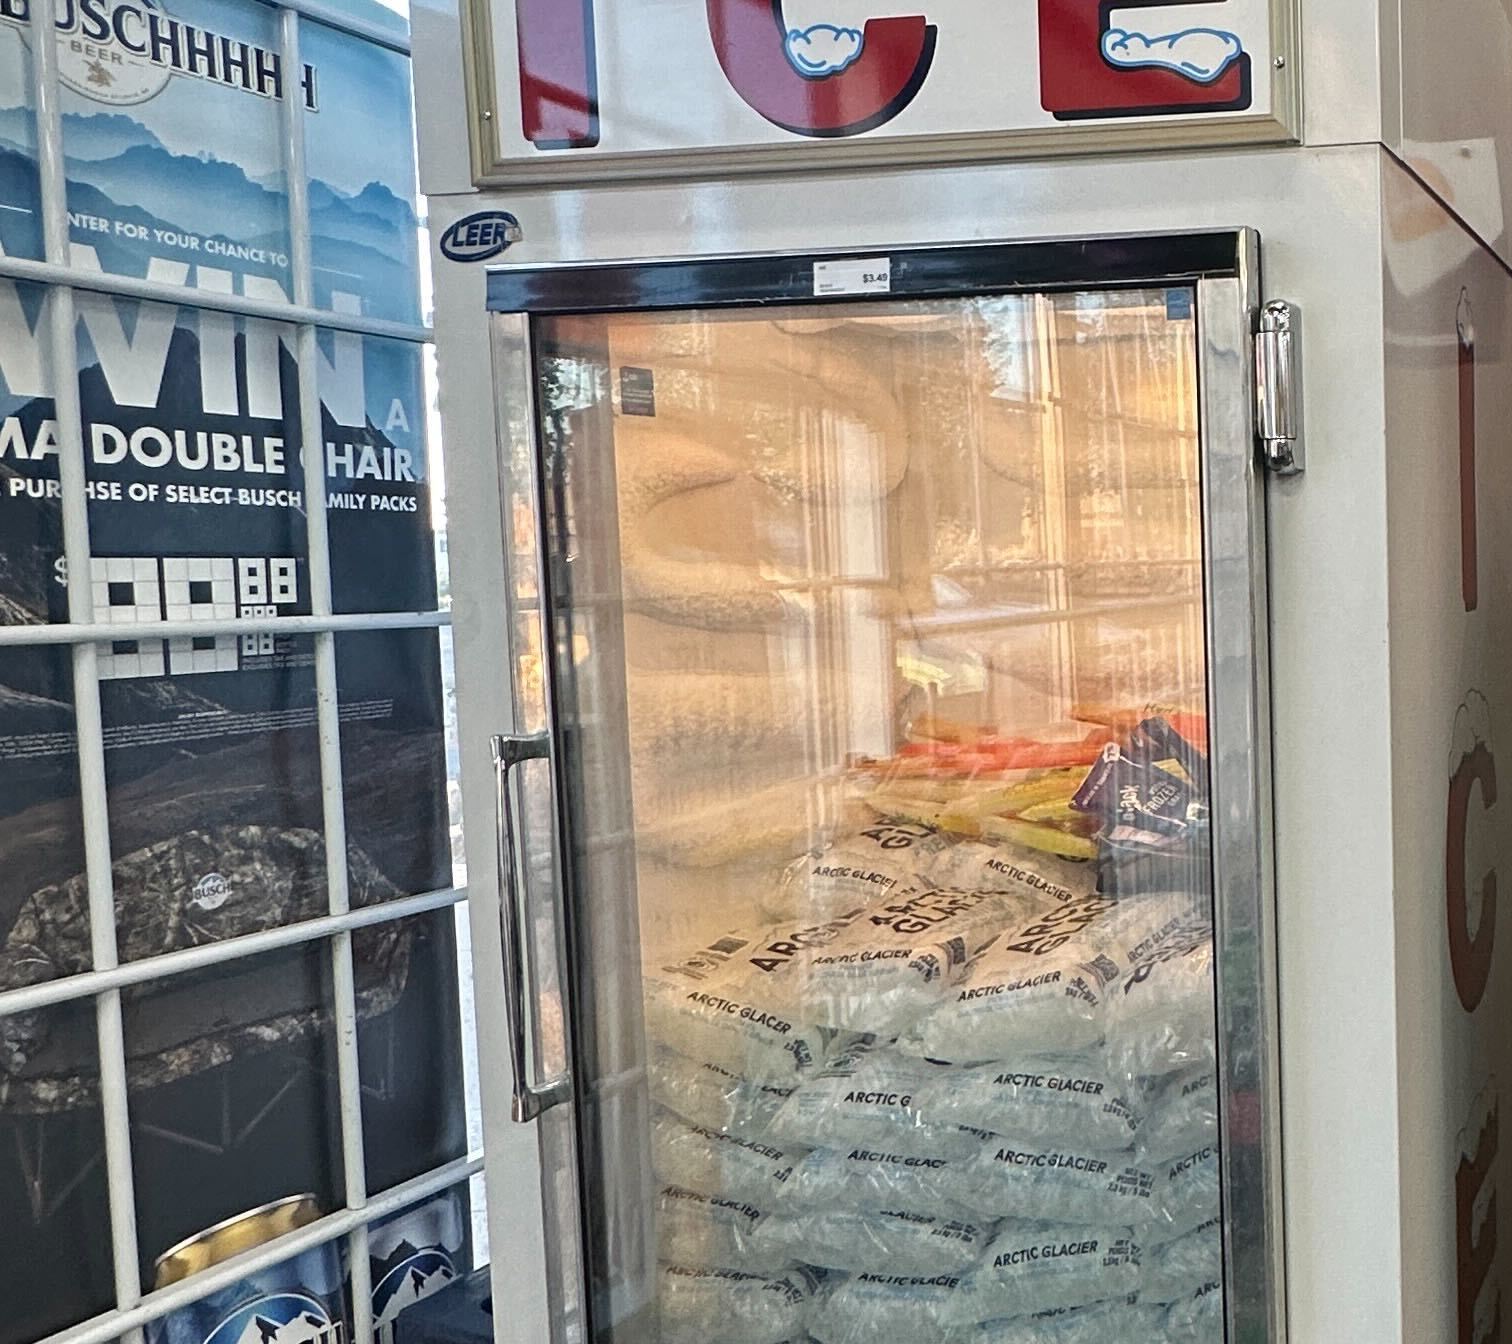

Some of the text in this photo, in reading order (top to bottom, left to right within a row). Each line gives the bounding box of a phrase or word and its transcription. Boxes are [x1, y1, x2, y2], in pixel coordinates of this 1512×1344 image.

[70, 42, 123, 66] BEER
[66, 213, 289, 268] NTER FOR YOUR CHANCE TO
[386, 397, 410, 433] A
[90, 422, 286, 475] DOUBLE
[302, 441, 415, 483] HAIR
[128, 483, 160, 503] OF
[164, 485, 237, 507] SELECT
[237, 487, 302, 509] BUSCH
[370, 494, 418, 513] PACKS
[985, 859, 1074, 903] ARCTIC GLACIER
[957, 983, 1006, 1002] ARCTIC
[1007, 970, 1062, 992] GLACIER
[687, 991, 740, 1014] ARCTIC
[844, 1091, 898, 1106] ARCTIC
[994, 1073, 1105, 1096] ARCTIC GLACIER
[994, 1147, 1108, 1175] ARCTIC GLACIER
[994, 1246, 1039, 1268] ARCTIC
[1041, 1239, 1099, 1258] GLACIER
